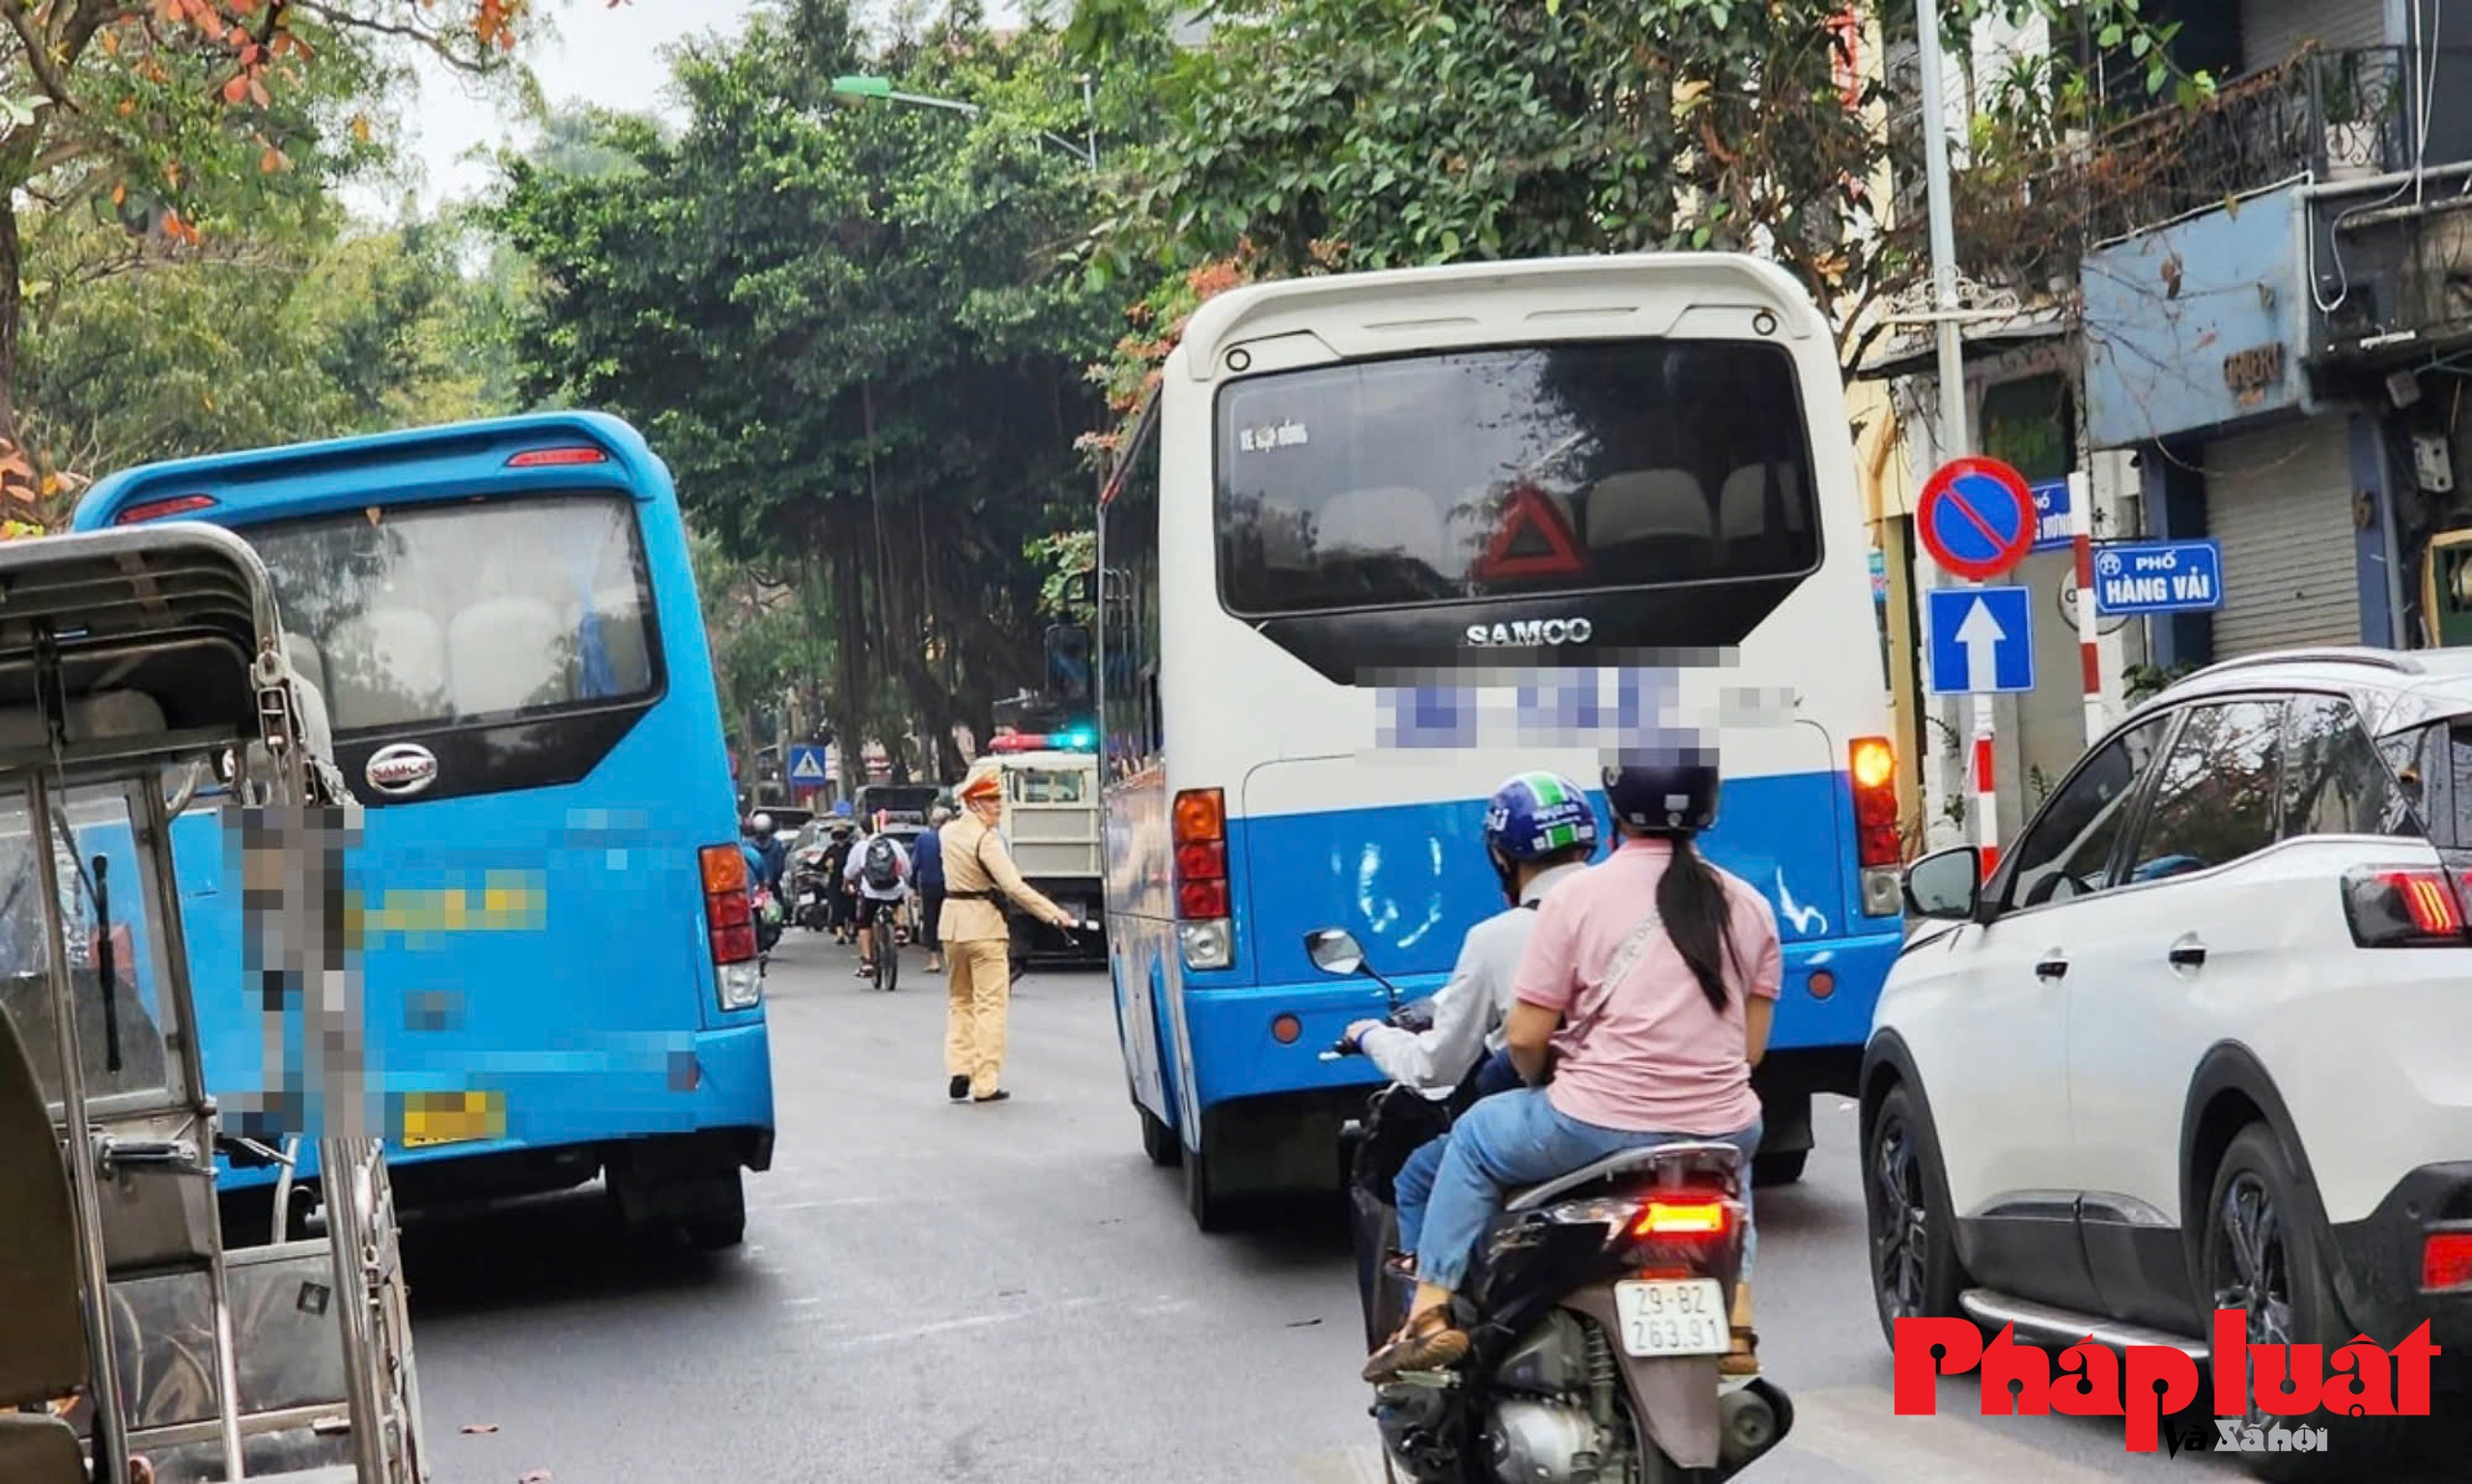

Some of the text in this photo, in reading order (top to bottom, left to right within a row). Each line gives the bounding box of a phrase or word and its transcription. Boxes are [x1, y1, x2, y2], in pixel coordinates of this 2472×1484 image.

[2135, 549, 2177, 571] PHỐ
[2106, 574, 2168, 604] HÀNG
[2173, 565, 2210, 600] VẢI
[1466, 617, 1592, 646] SAMCO
[1632, 1318, 1722, 1350] 263.91
